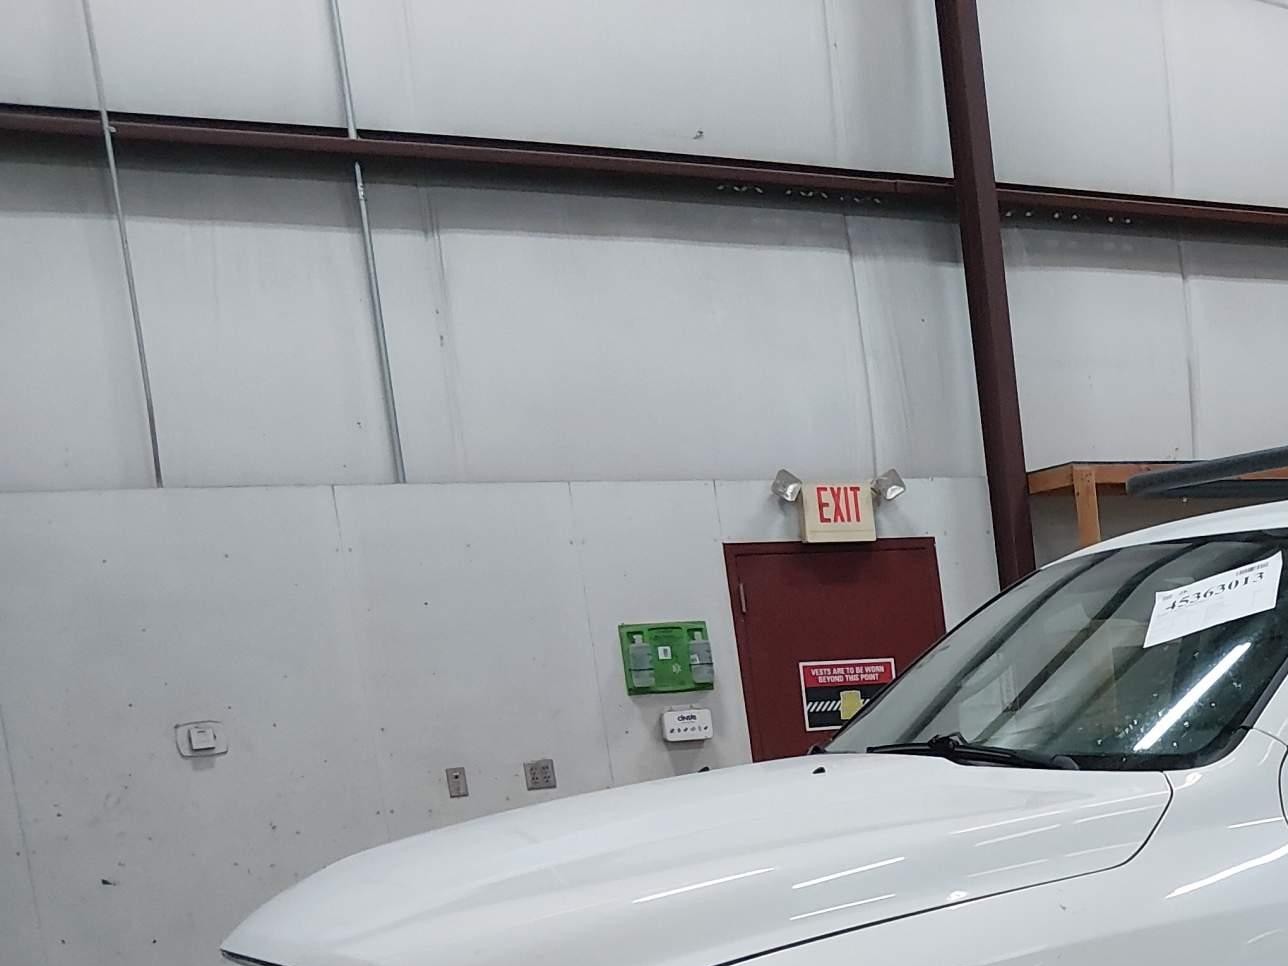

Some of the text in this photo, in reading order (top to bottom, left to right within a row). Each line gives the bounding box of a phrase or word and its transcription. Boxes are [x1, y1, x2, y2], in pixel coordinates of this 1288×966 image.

[816, 487, 861, 523] EXIT
[1165, 572, 1265, 610] 45363013
[811, 665, 885, 676] VESTS ARE TO BE WORN
[818, 673, 880, 683] BEYOND THIS POINT
